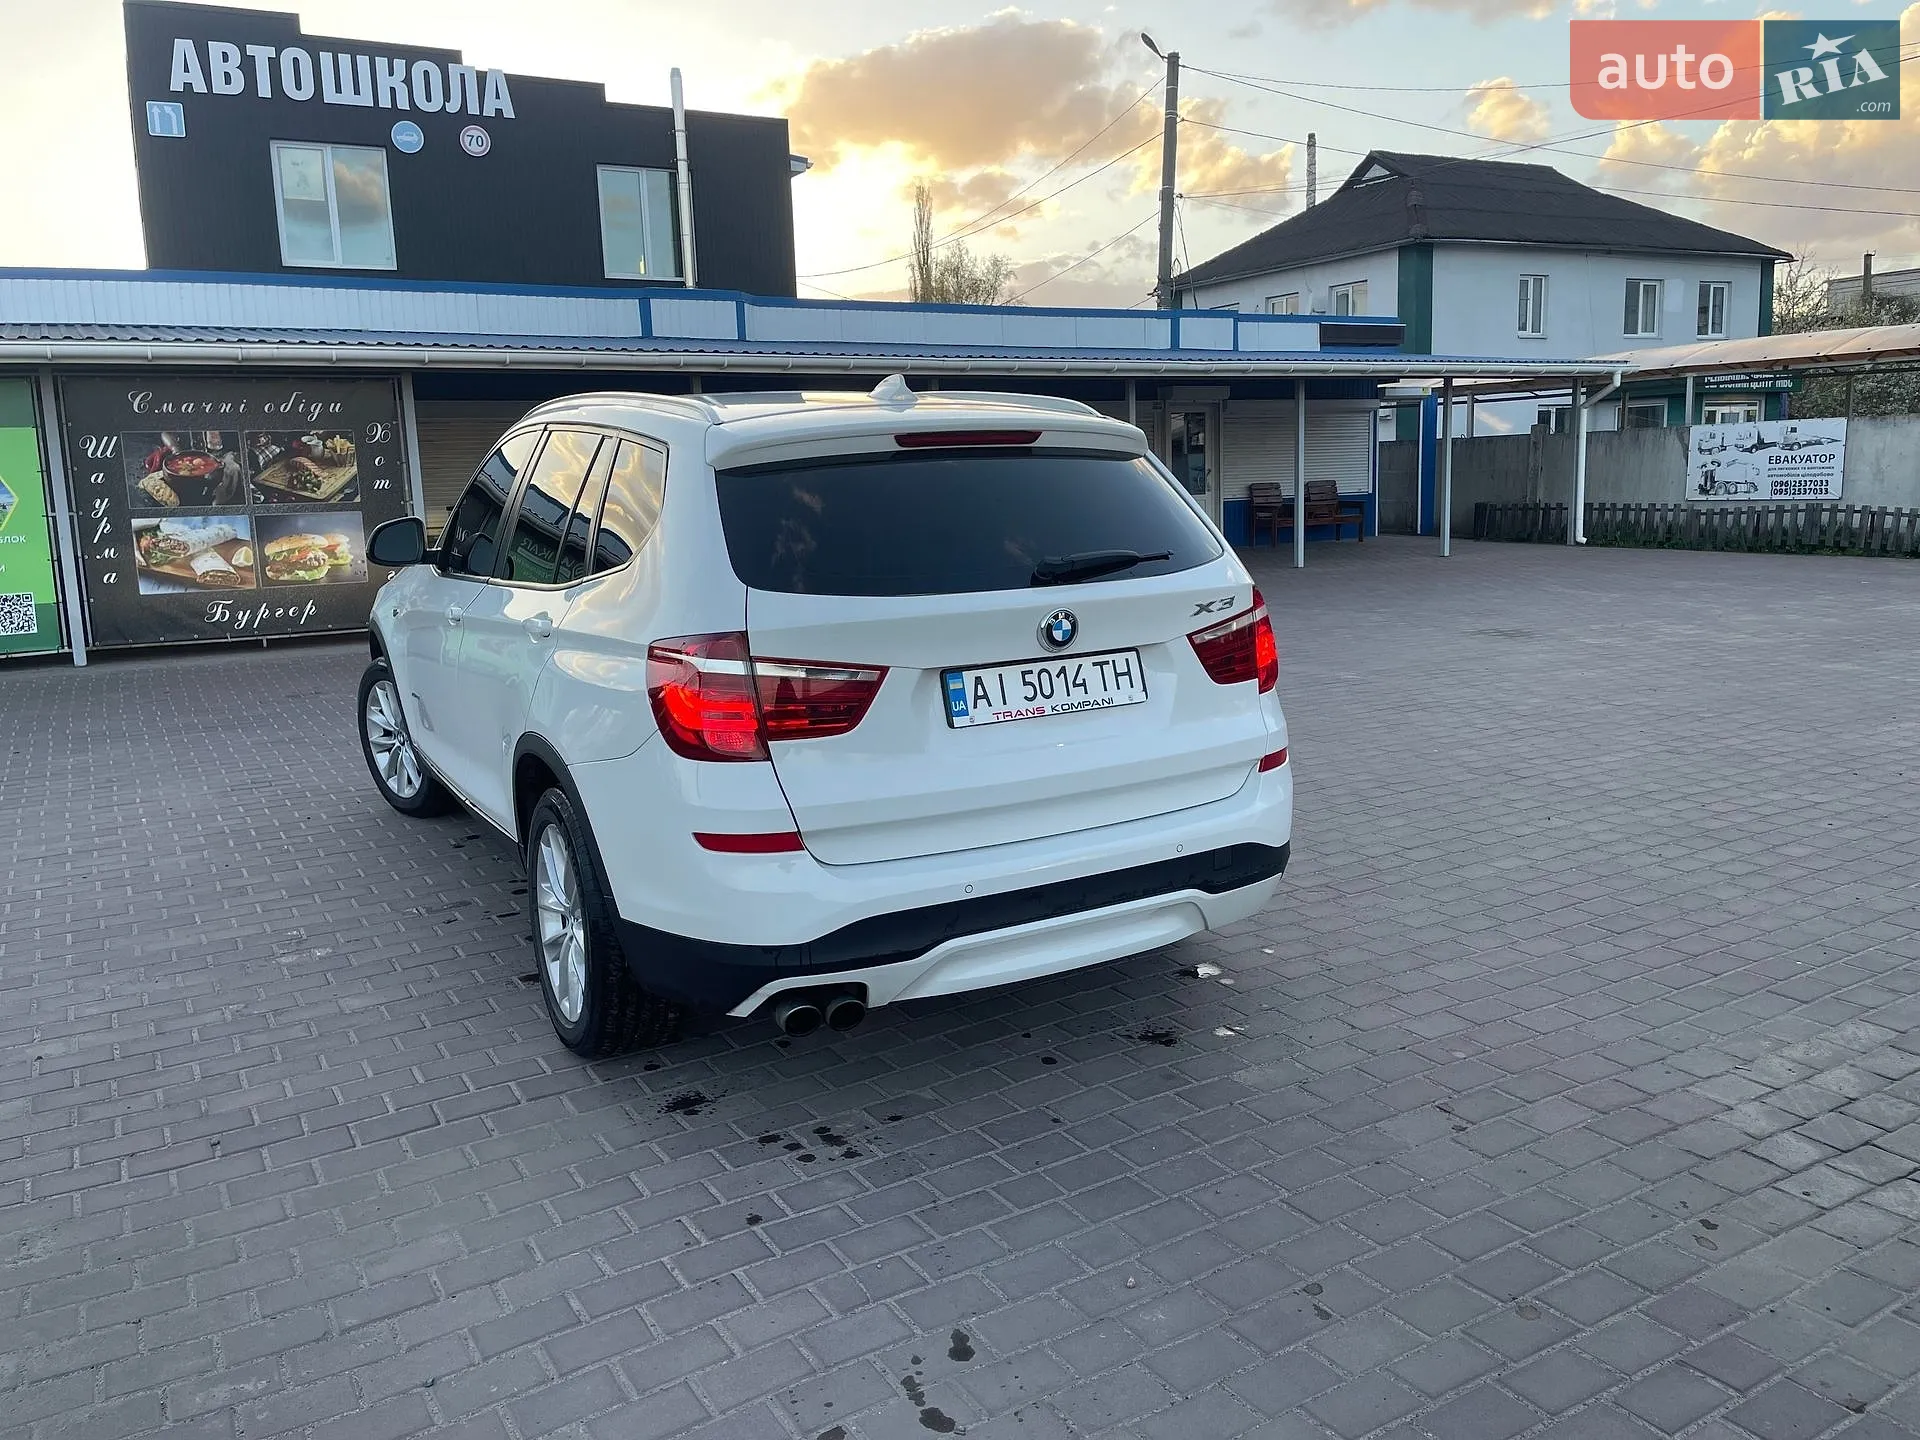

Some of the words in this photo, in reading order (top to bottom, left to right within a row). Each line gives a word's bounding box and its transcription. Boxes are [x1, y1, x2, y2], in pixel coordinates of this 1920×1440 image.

[169, 37, 516, 120] АВТОШКОЛА
[466, 134, 484, 148] 70
[127, 390, 248, 415] Смачні
[264, 392, 344, 422] обіди
[1768, 453, 1836, 465] ЕВАКУАТОР
[1770, 480, 1829, 488] (096)2537033
[1770, 488, 1829, 496] (095)2537033
[78, 434, 119, 584] Шаурма
[203, 599, 318, 629] Бургер
[1189, 595, 1237, 617] X3
[1022, 663, 1089, 703] 5014
[1092, 657, 1135, 692] TH
[951, 700, 967, 713] UA
[992, 705, 1047, 721] TRANS
[1051, 697, 1115, 713] KOMPANI
